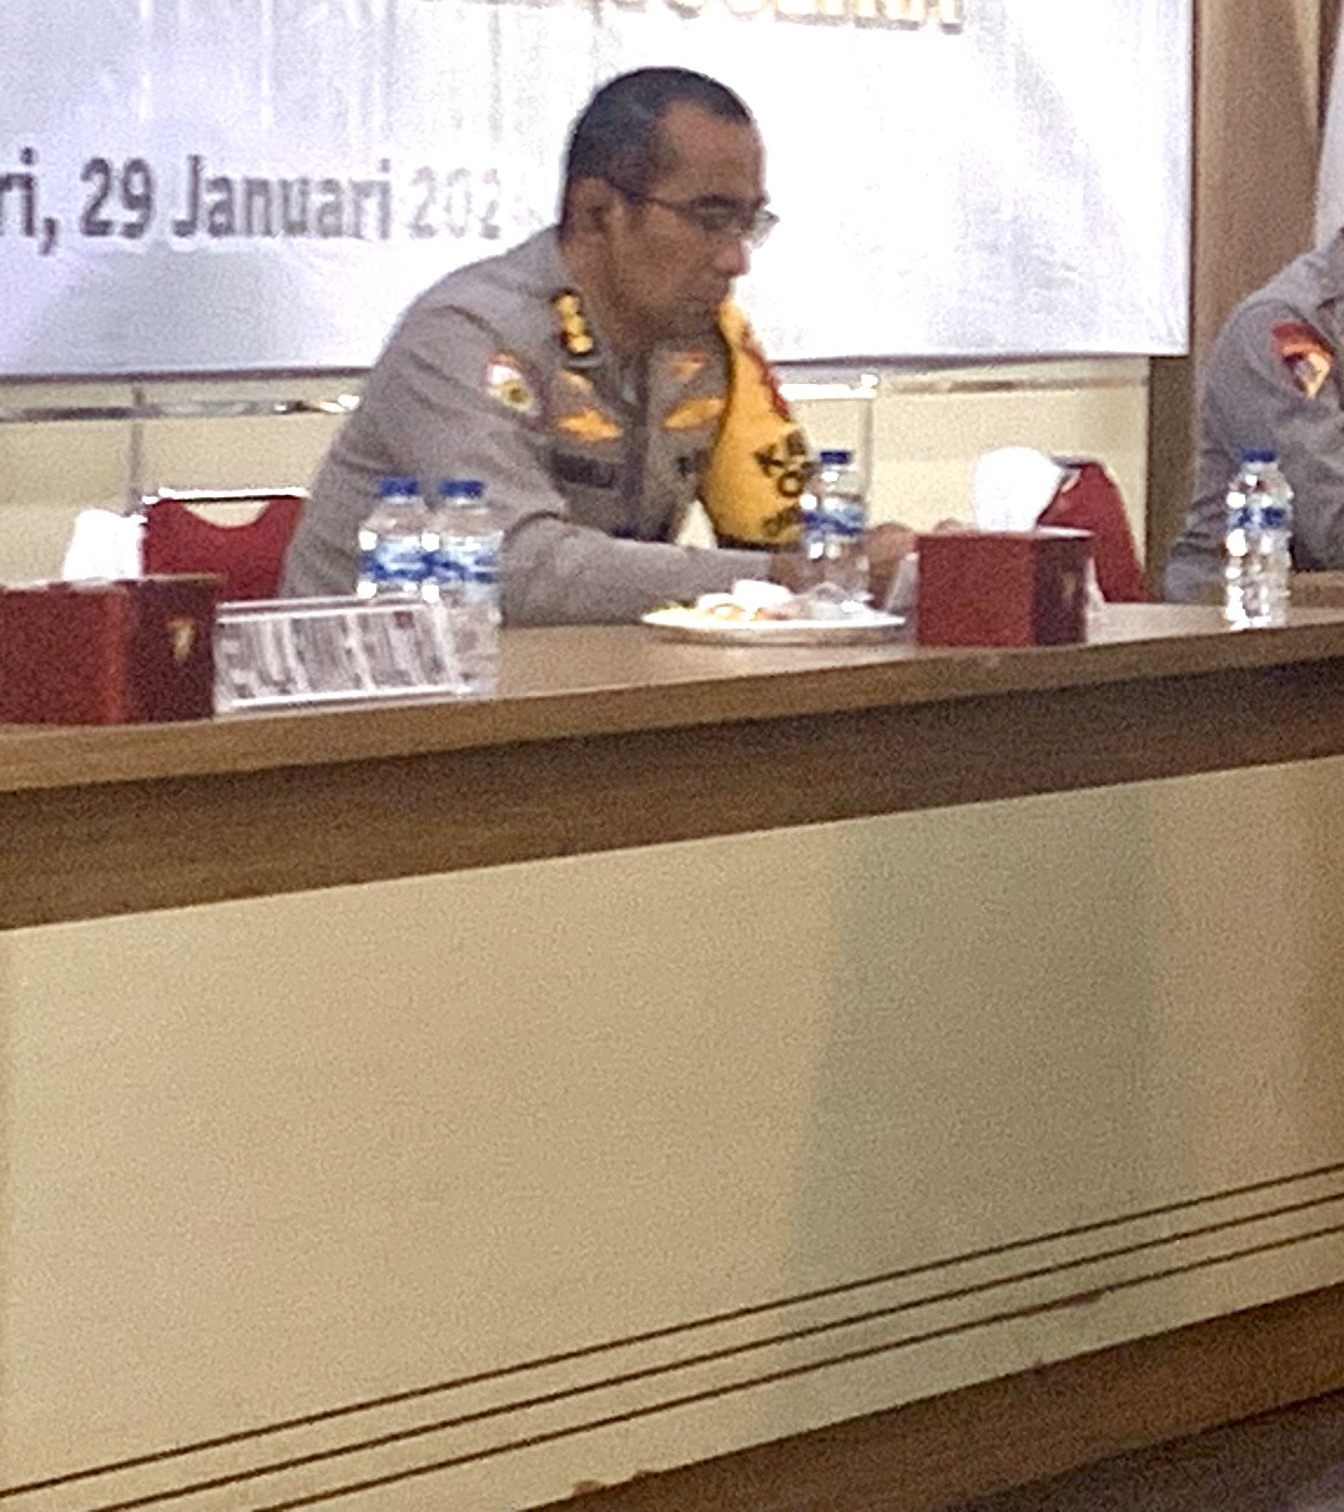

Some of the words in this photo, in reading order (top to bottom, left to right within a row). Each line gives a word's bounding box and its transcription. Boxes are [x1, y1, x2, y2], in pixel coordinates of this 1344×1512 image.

[81, 156, 156, 239] 29
[173, 153, 392, 242] Januari
[408, 165, 546, 240] 202
